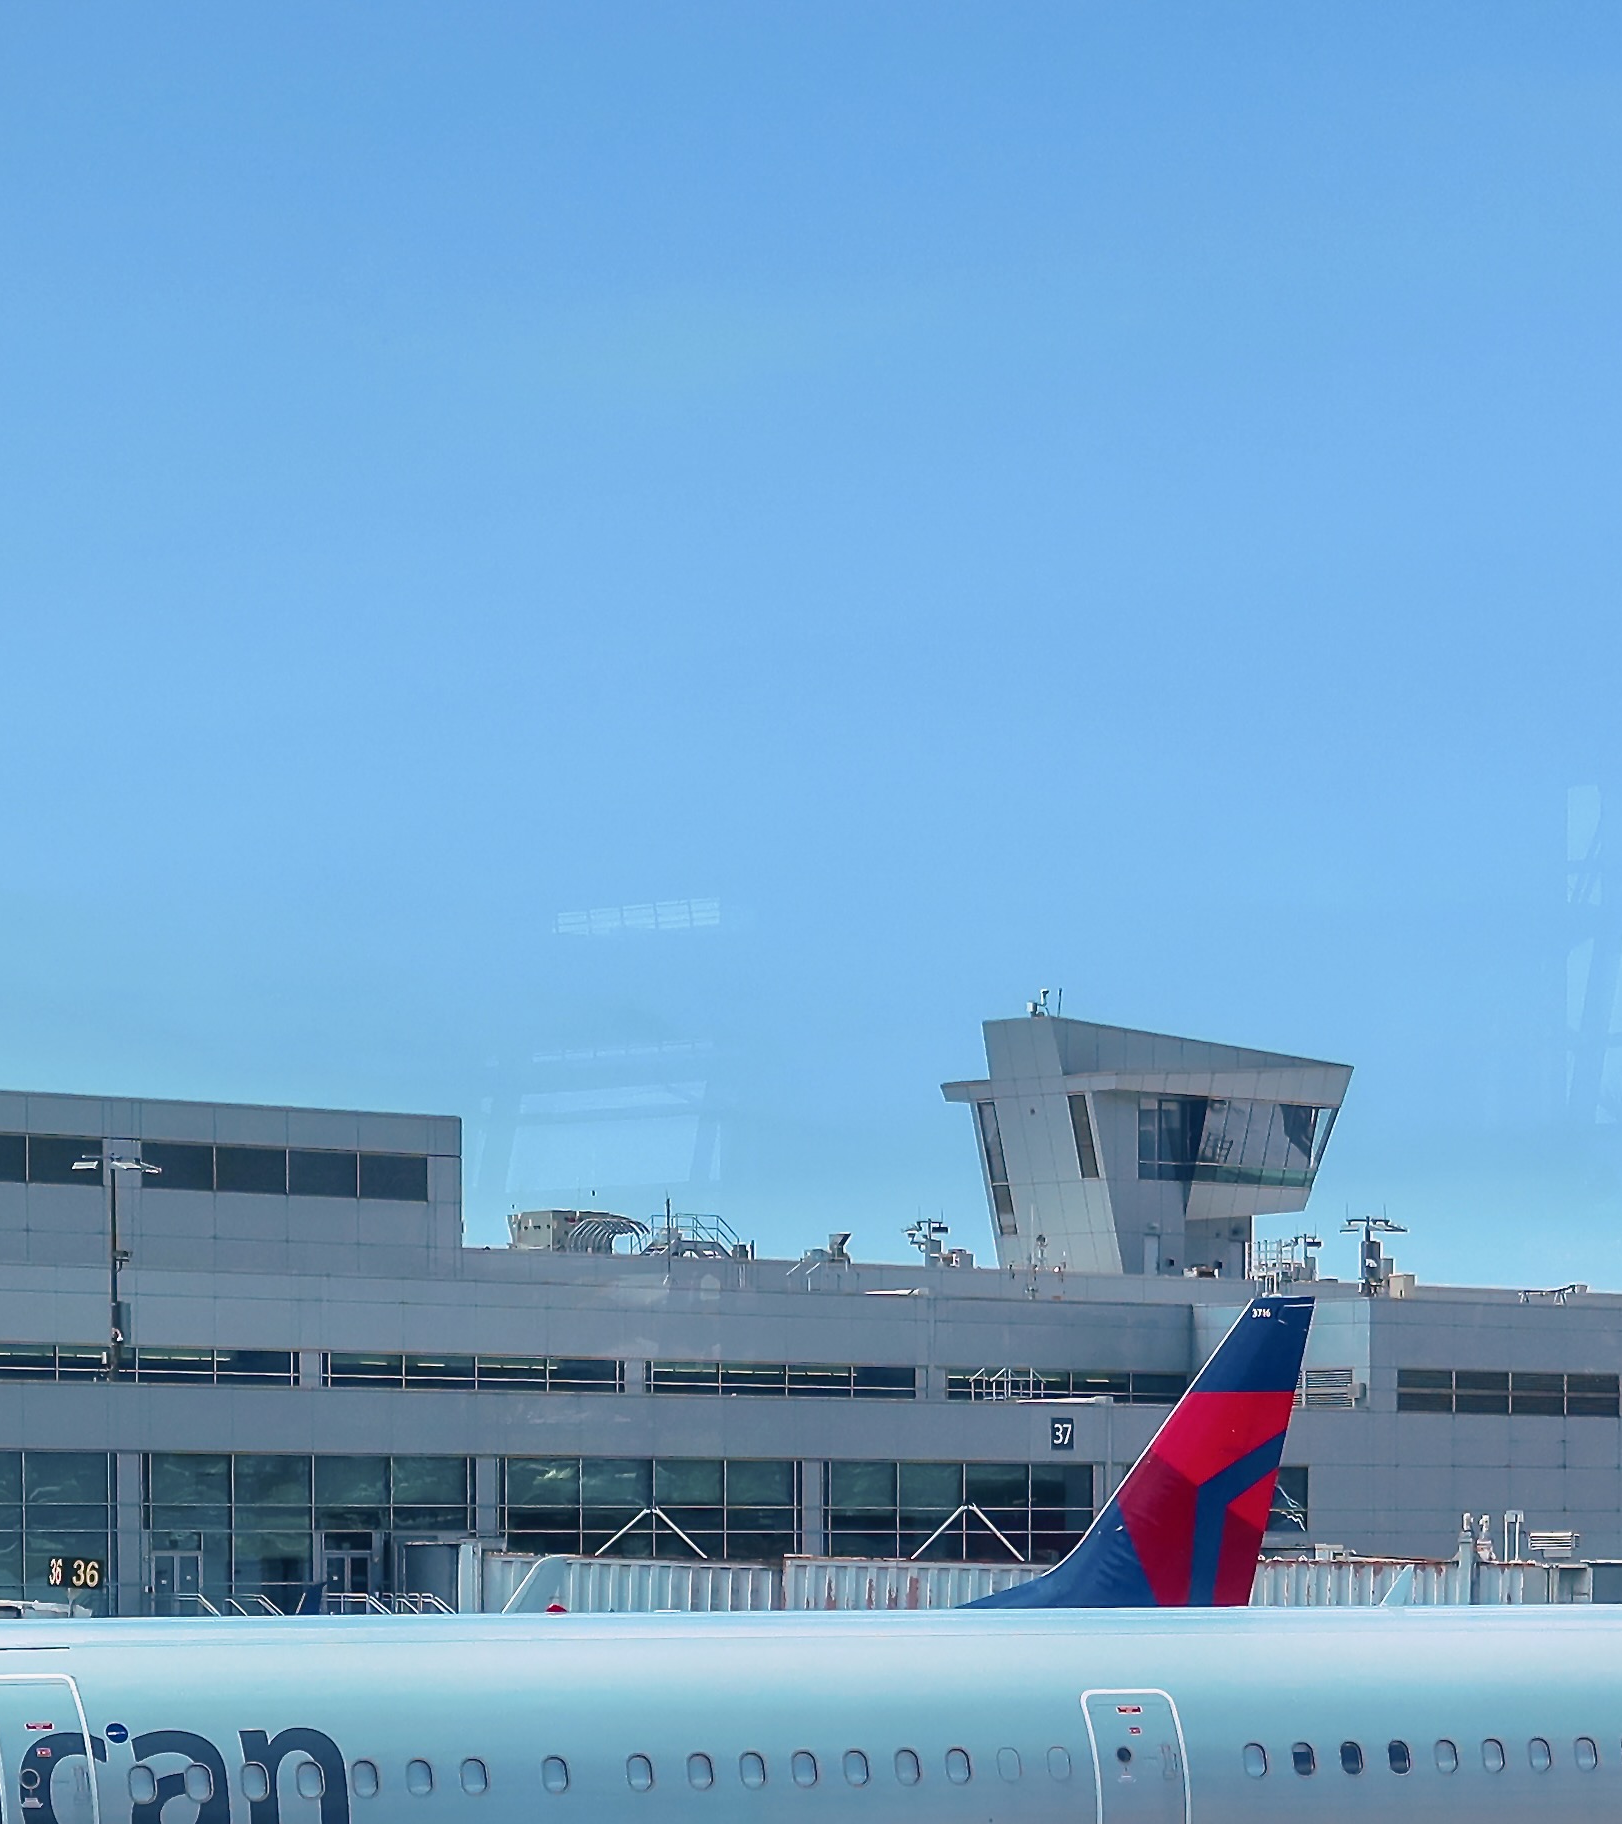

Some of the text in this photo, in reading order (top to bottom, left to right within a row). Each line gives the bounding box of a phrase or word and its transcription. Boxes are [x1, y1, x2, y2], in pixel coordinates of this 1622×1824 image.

[1053, 1423, 1072, 1445] 37
[49, 1558, 63, 1586] 36
[72, 1559, 99, 1588] 36
